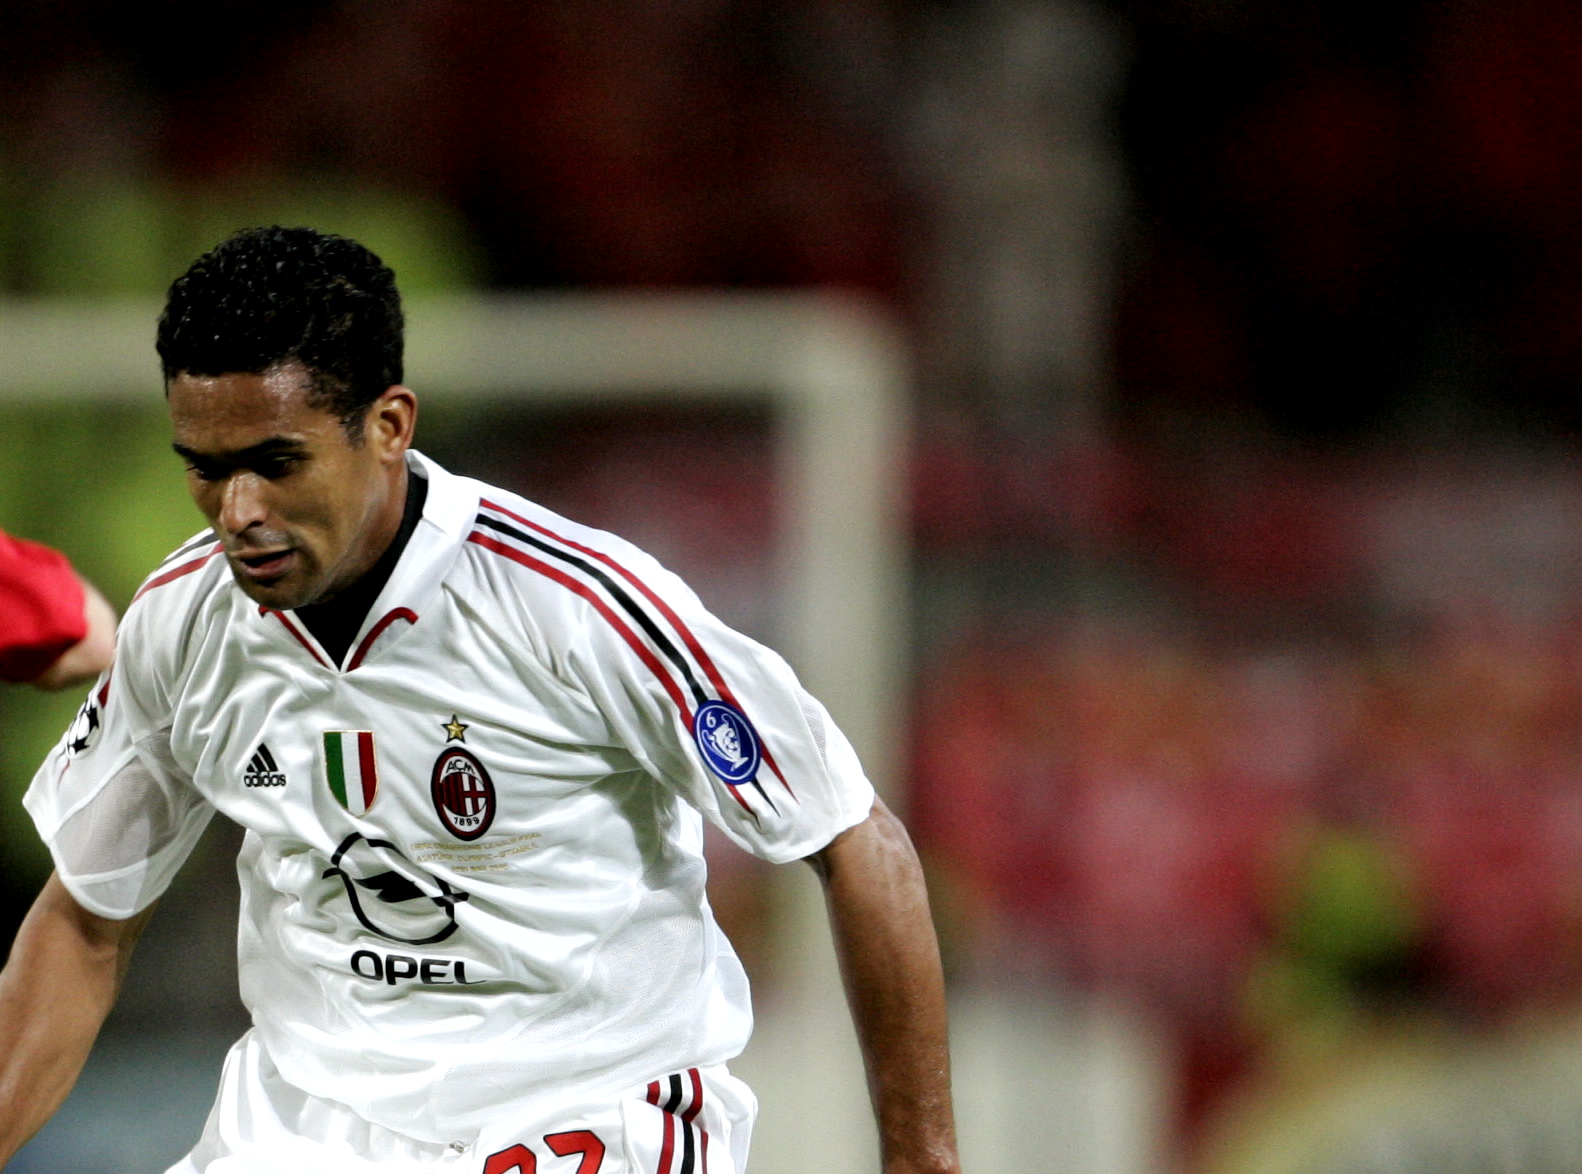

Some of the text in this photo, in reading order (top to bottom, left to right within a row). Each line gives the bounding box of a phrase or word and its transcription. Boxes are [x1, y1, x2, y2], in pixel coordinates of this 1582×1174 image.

[705, 710, 717, 729] 6
[445, 759, 476, 776] ACM
[243, 771, 287, 788] adidas
[453, 816, 481, 827] 1899
[349, 949, 490, 986] OPEL
